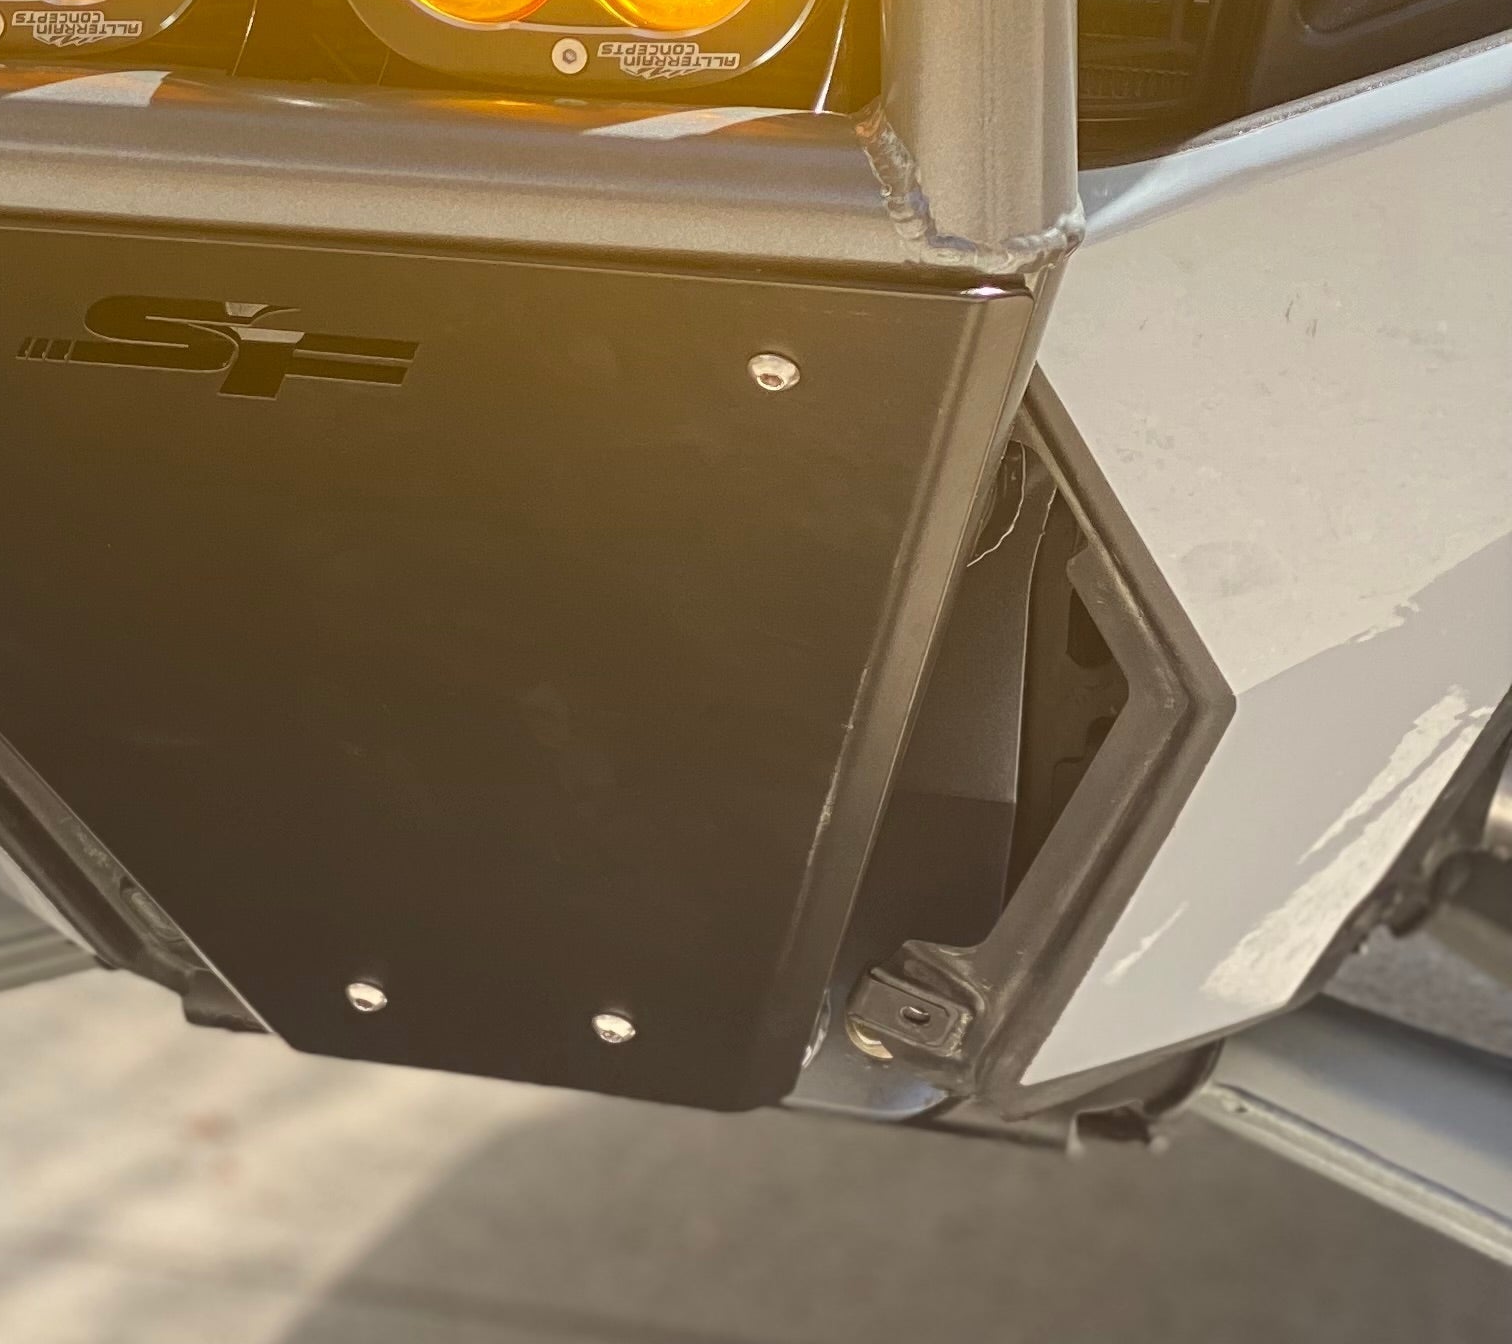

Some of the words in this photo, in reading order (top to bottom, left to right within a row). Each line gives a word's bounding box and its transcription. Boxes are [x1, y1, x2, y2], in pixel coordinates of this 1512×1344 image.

[15, 12, 101, 24] CONCEPTS
[36, 23, 139, 35] ALLTERRAIN
[601, 43, 695, 56] CONCEPTS
[623, 55, 737, 68] ALLTERRAIN
[15, 293, 421, 400] SF
